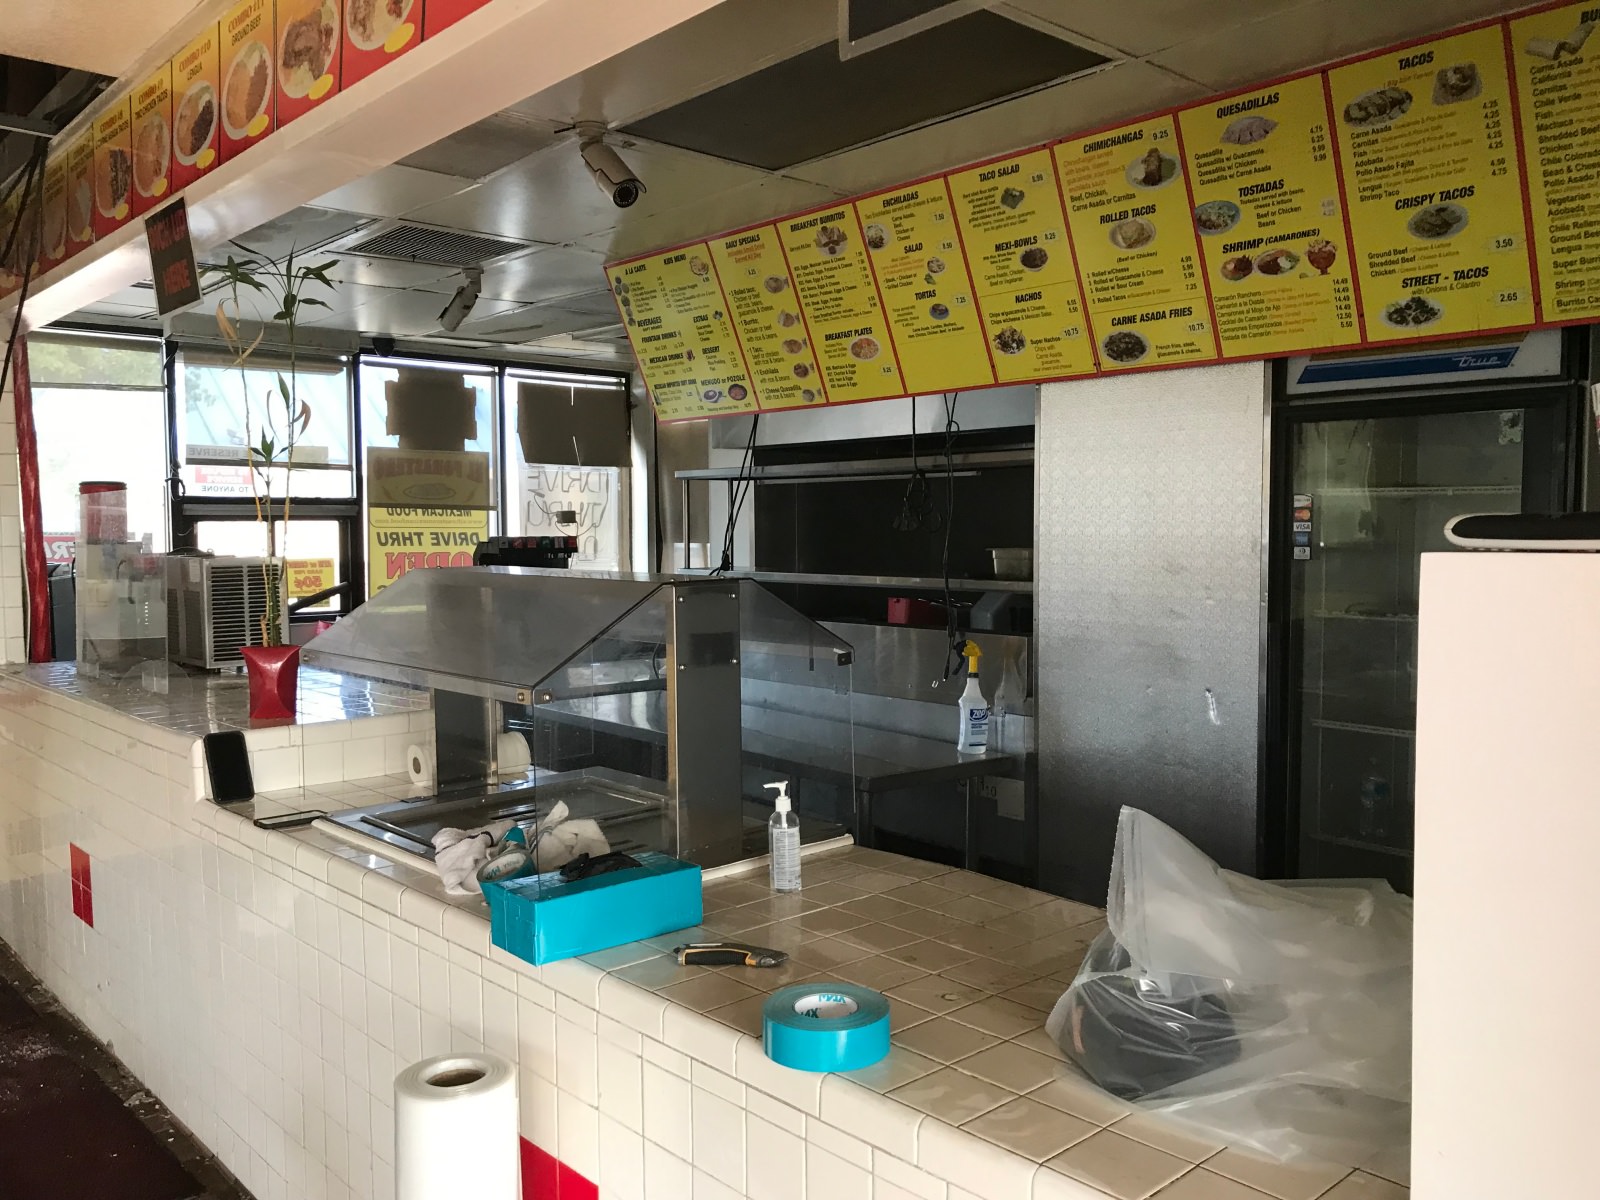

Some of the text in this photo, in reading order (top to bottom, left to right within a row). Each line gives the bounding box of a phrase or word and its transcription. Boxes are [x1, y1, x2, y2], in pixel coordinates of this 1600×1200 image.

[1398, 51, 1433, 69] TACOS
[1217, 92, 1279, 118] QUESADILLAS
[1350, 130, 1369, 139] Carne
[1371, 125, 1391, 134] Asada
[1482, 99, 1498, 109] 4.25
[1352, 109, 1499, 149] Carnitas 4.25
[1083, 129, 1168, 153] CHIMICHANGAS 9.25
[1353, 120, 1500, 158] Fish 4.25
[1355, 130, 1501, 167] Adobada 4.25
[1234, 159, 1257, 168] Chicken
[1312, 144, 1325, 152] 9.99
[1235, 169, 1252, 177] Carne
[1253, 165, 1271, 173] Asada
[1313, 153, 1326, 161] 9.99
[1355, 140, 1503, 176] Pollo Asado Fajita 4.25
[979, 164, 1019, 181] TACO SALAD
[1238, 179, 1283, 196] TOSTADAS
[1358, 183, 1382, 192] Lengua
[1359, 193, 1382, 202] Shrimp
[1491, 167, 1507, 176] 4.75
[882, 191, 918, 207] ENCHILADAS
[1072, 203, 1087, 211] Carne
[1088, 199, 1105, 207] Asada
[1112, 193, 1135, 202] Carnitas
[1395, 185, 1474, 210] CRISPY TACOS
[790, 211, 845, 231] BREAKFAST BURRITOS
[1100, 204, 1155, 224] ROLLED TACOS
[1256, 211, 1269, 219] Beef
[1277, 206, 1301, 214] Chicken
[738, 234, 760, 245] SPECIALS
[904, 242, 922, 253] SALAD
[995, 235, 1037, 251] MEXI-BOWLS
[1222, 228, 1319, 253] SHRIMP (CAMARONES)
[1367, 247, 1407, 259] Ground Beef
[1369, 238, 1512, 268] Shredded Beef 3.50
[1370, 269, 1396, 277] Chicken
[1402, 266, 1488, 288] STREET TACOS
[915, 289, 936, 299] TORTAS
[1015, 291, 1041, 303] NACHOS
[1455, 281, 1480, 289] Cilantro
[1500, 292, 1517, 302] 2.65
[1111, 306, 1192, 326] CARNE ASADA FRIES
[825, 326, 872, 341] BREAKFAST PLATES
[1188, 322, 1204, 331] 10.75
